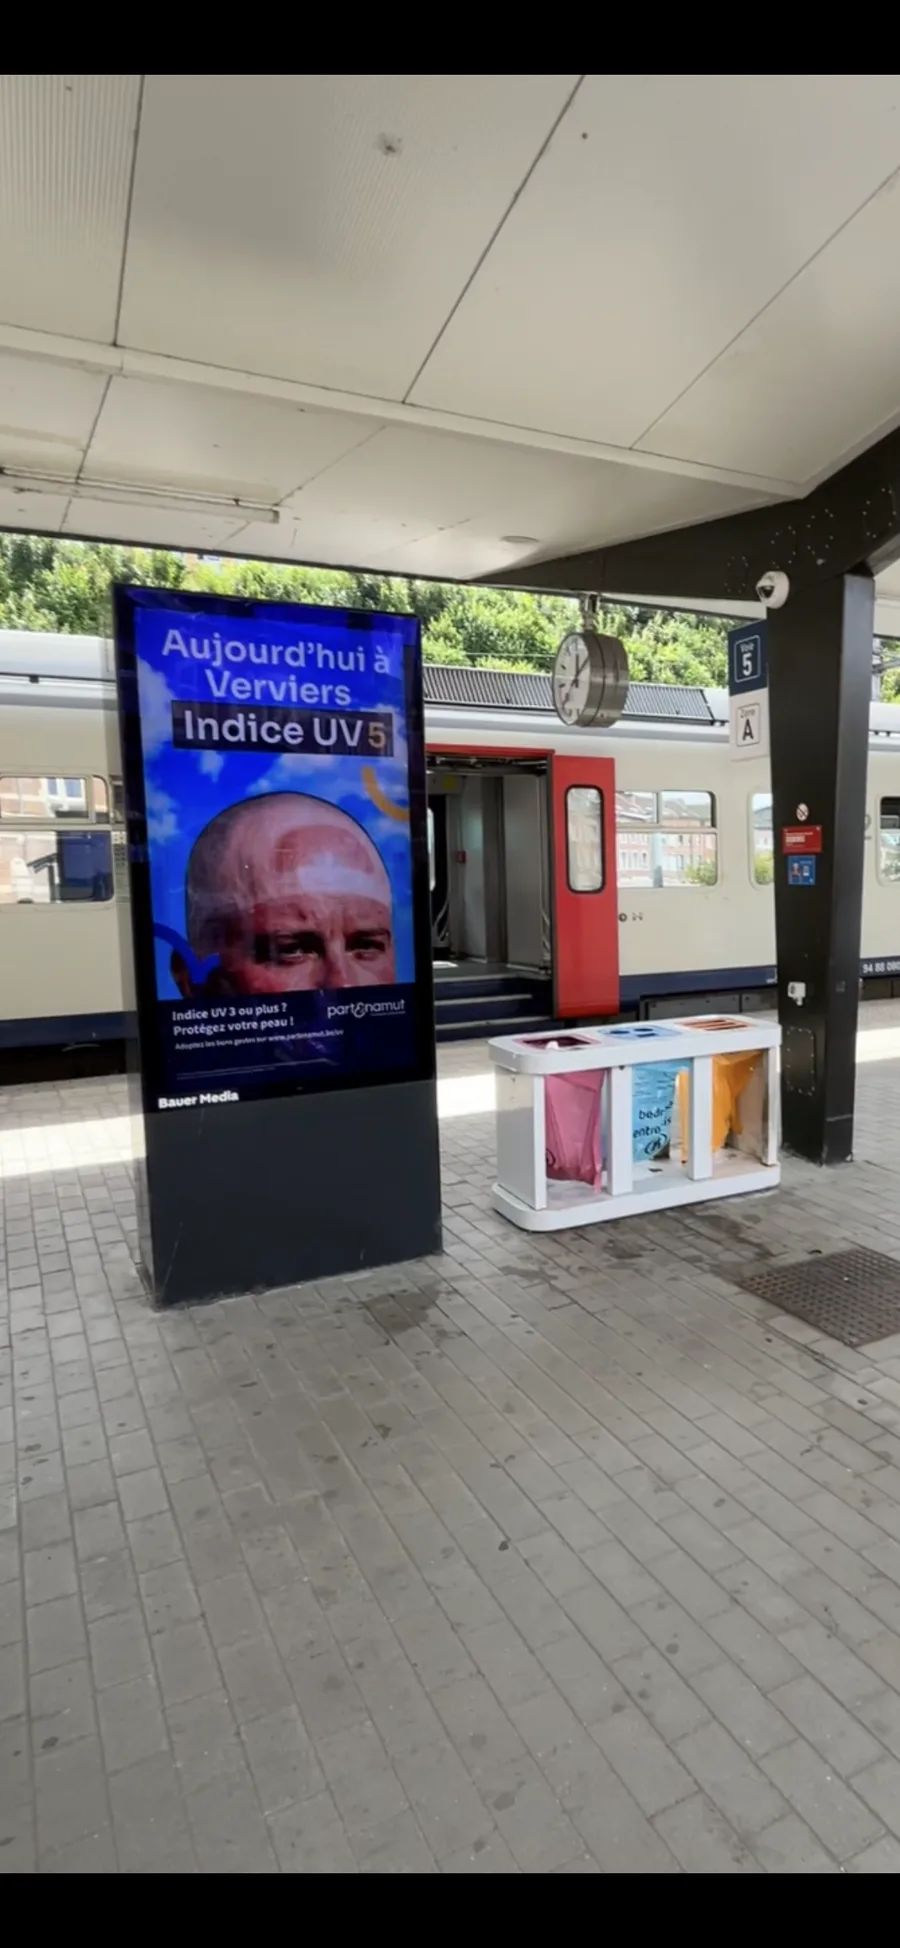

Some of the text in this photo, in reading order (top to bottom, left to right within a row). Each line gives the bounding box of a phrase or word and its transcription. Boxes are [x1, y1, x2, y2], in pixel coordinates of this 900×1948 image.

[740, 642, 755, 653] Voie
[373, 646, 391, 674] à
[742, 652, 752, 676] 5
[205, 669, 352, 706] Verviers
[184, 710, 387, 749] Indice UV 5
[742, 718, 754, 741] A
[172, 1003, 288, 1021] Indice UV 3 ou plus ?
[173, 1021, 226, 1037] Protégez
[227, 1020, 259, 1032] votre
[260, 1018, 288, 1031] peau
[158, 1090, 239, 1109] Bauer Media
